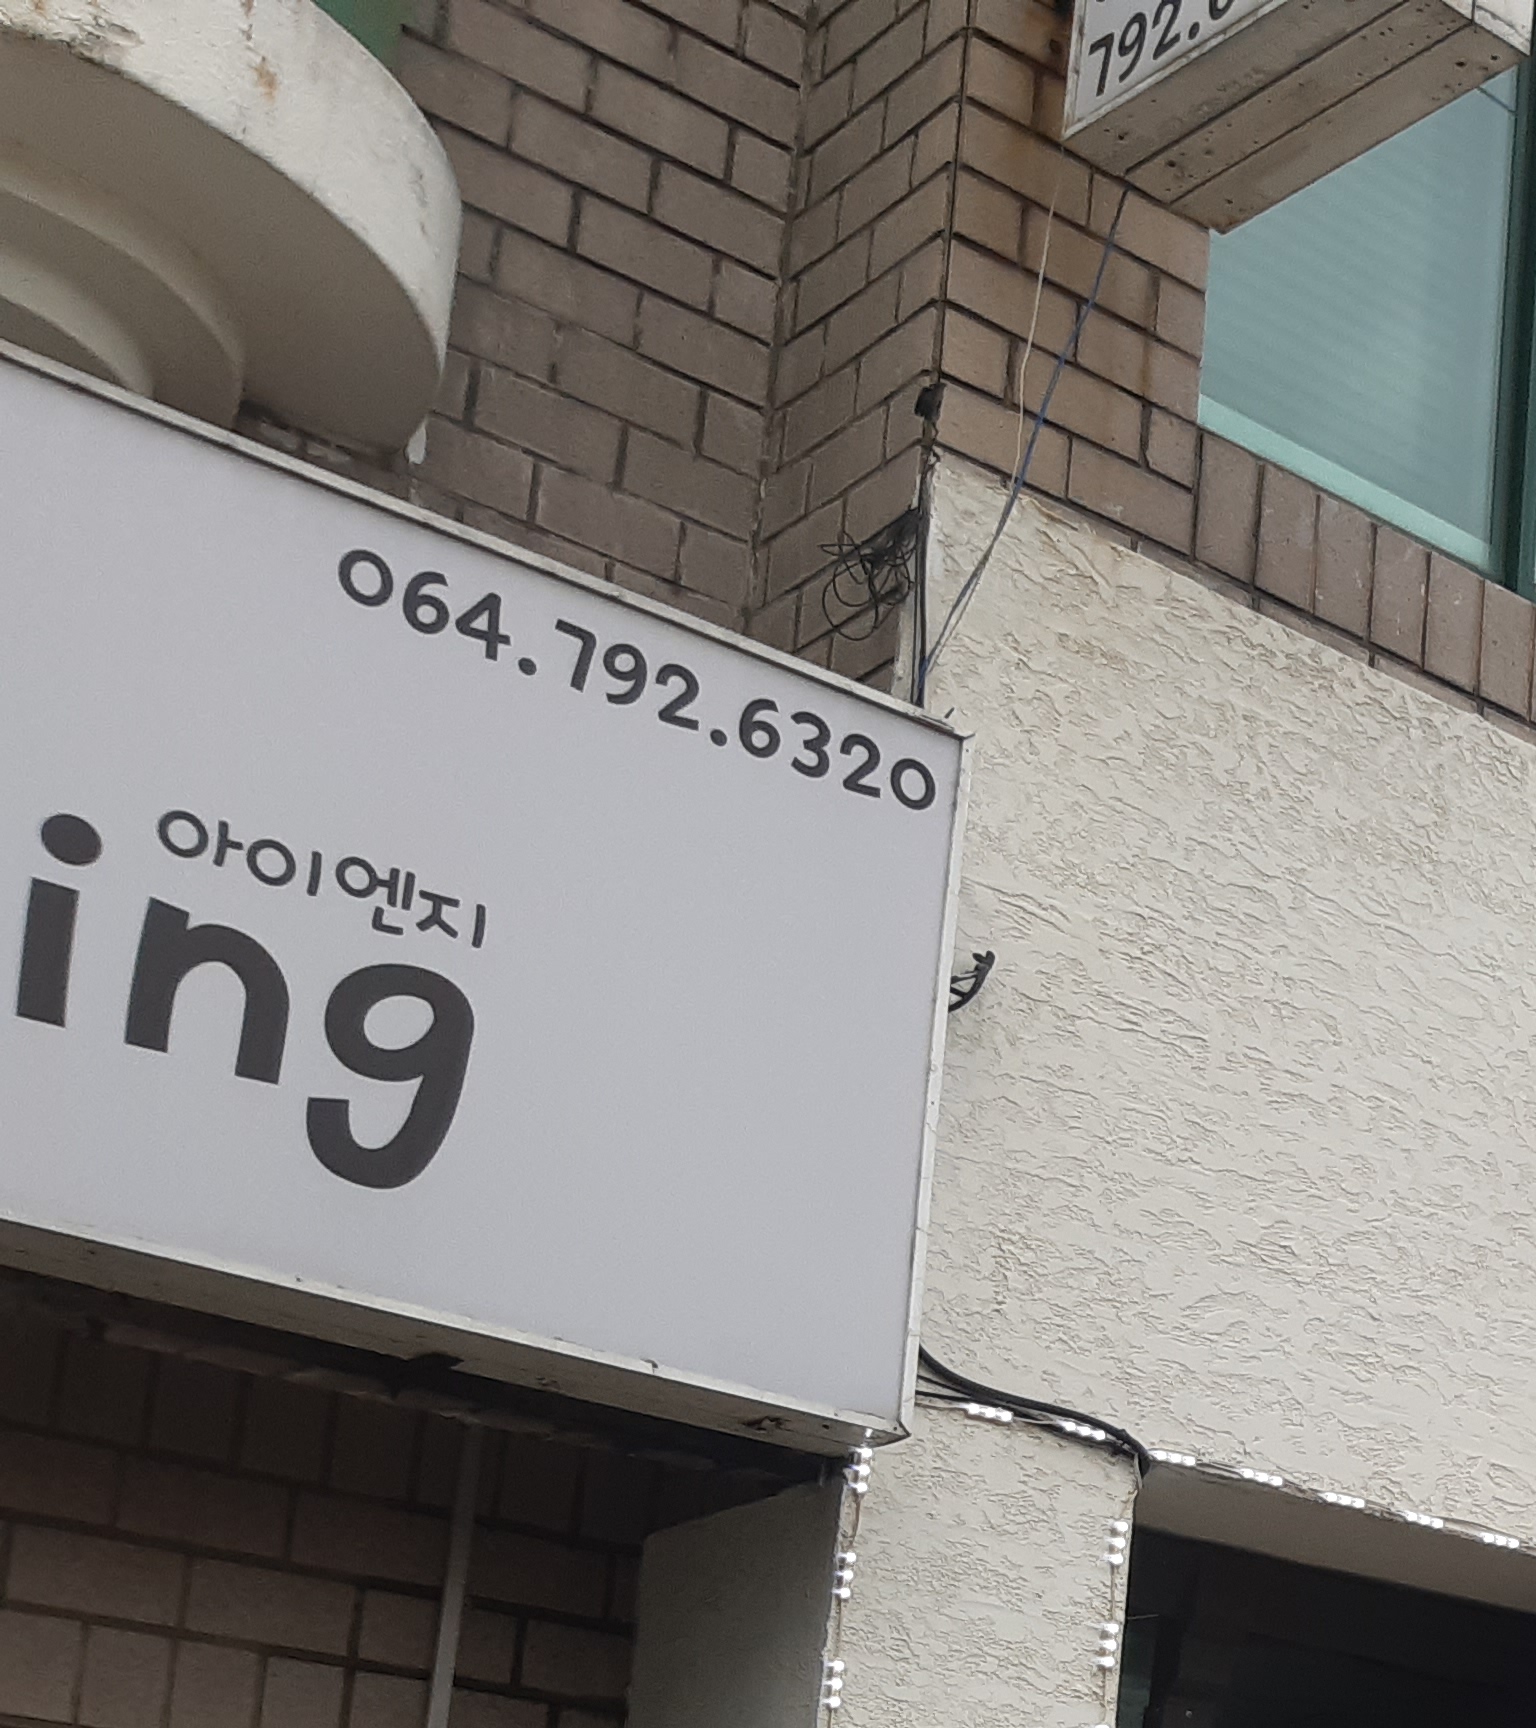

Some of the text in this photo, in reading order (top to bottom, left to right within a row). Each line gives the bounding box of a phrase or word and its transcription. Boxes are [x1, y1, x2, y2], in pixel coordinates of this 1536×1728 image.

[337, 549, 937, 810] 064.792.6320
[16, 813, 475, 1189] ing
[157, 810, 487, 948] 아이엔지
